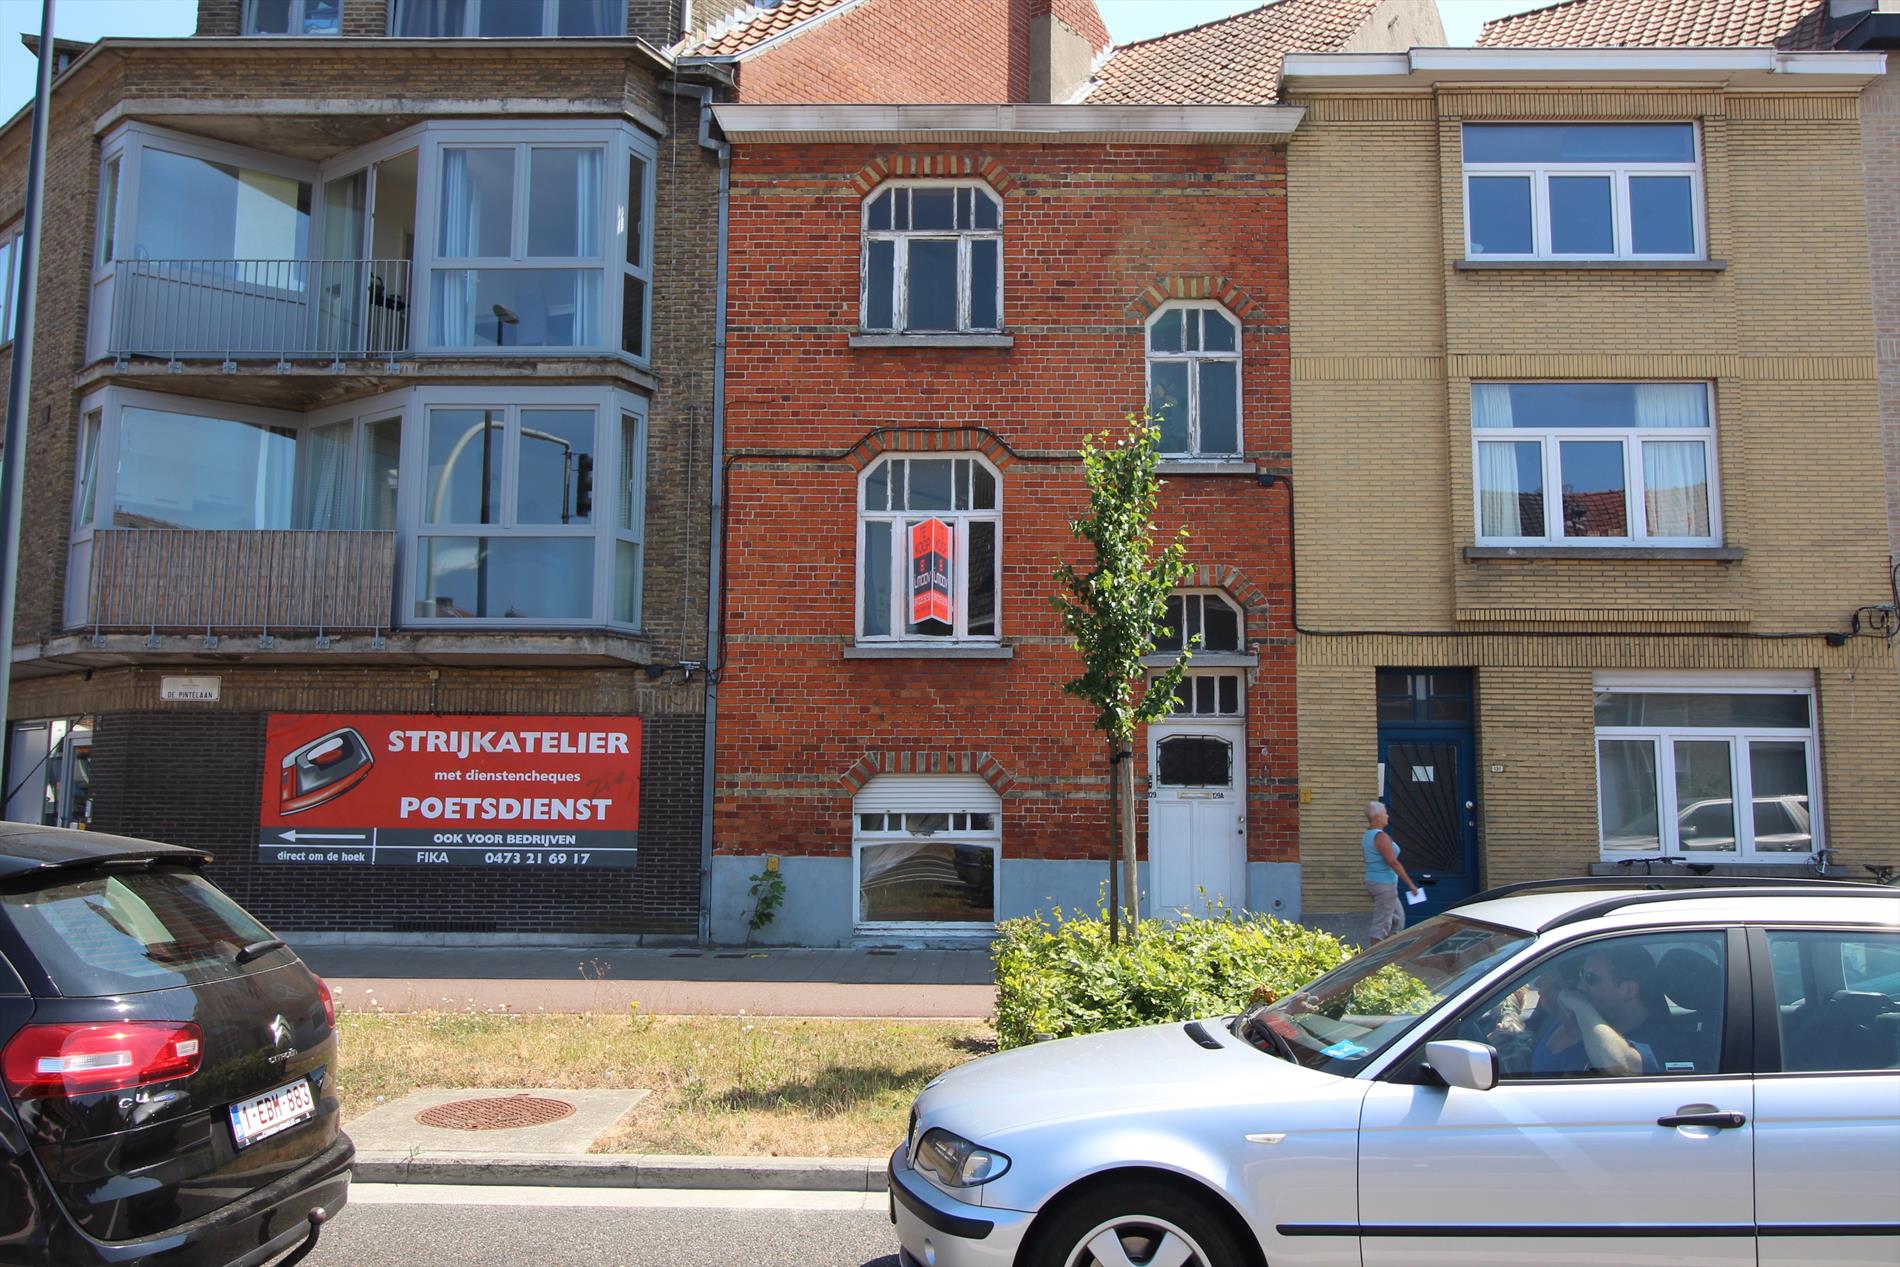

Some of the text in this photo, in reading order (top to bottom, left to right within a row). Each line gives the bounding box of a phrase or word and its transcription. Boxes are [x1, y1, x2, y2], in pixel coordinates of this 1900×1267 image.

[167, 691, 213, 699] DE PINTELAAN
[388, 730, 630, 759] STRIJKATELIER
[434, 770, 462, 781] met
[465, 769, 581, 785] dienstencheques
[400, 796, 613, 821] POETSDIENST
[433, 833, 576, 847] OOK VOOR BEDRIJVEN
[277, 850, 366, 862] direct om de hoek
[416, 851, 449, 863] FIKA
[484, 852, 591, 865] 0473 21 69 17
